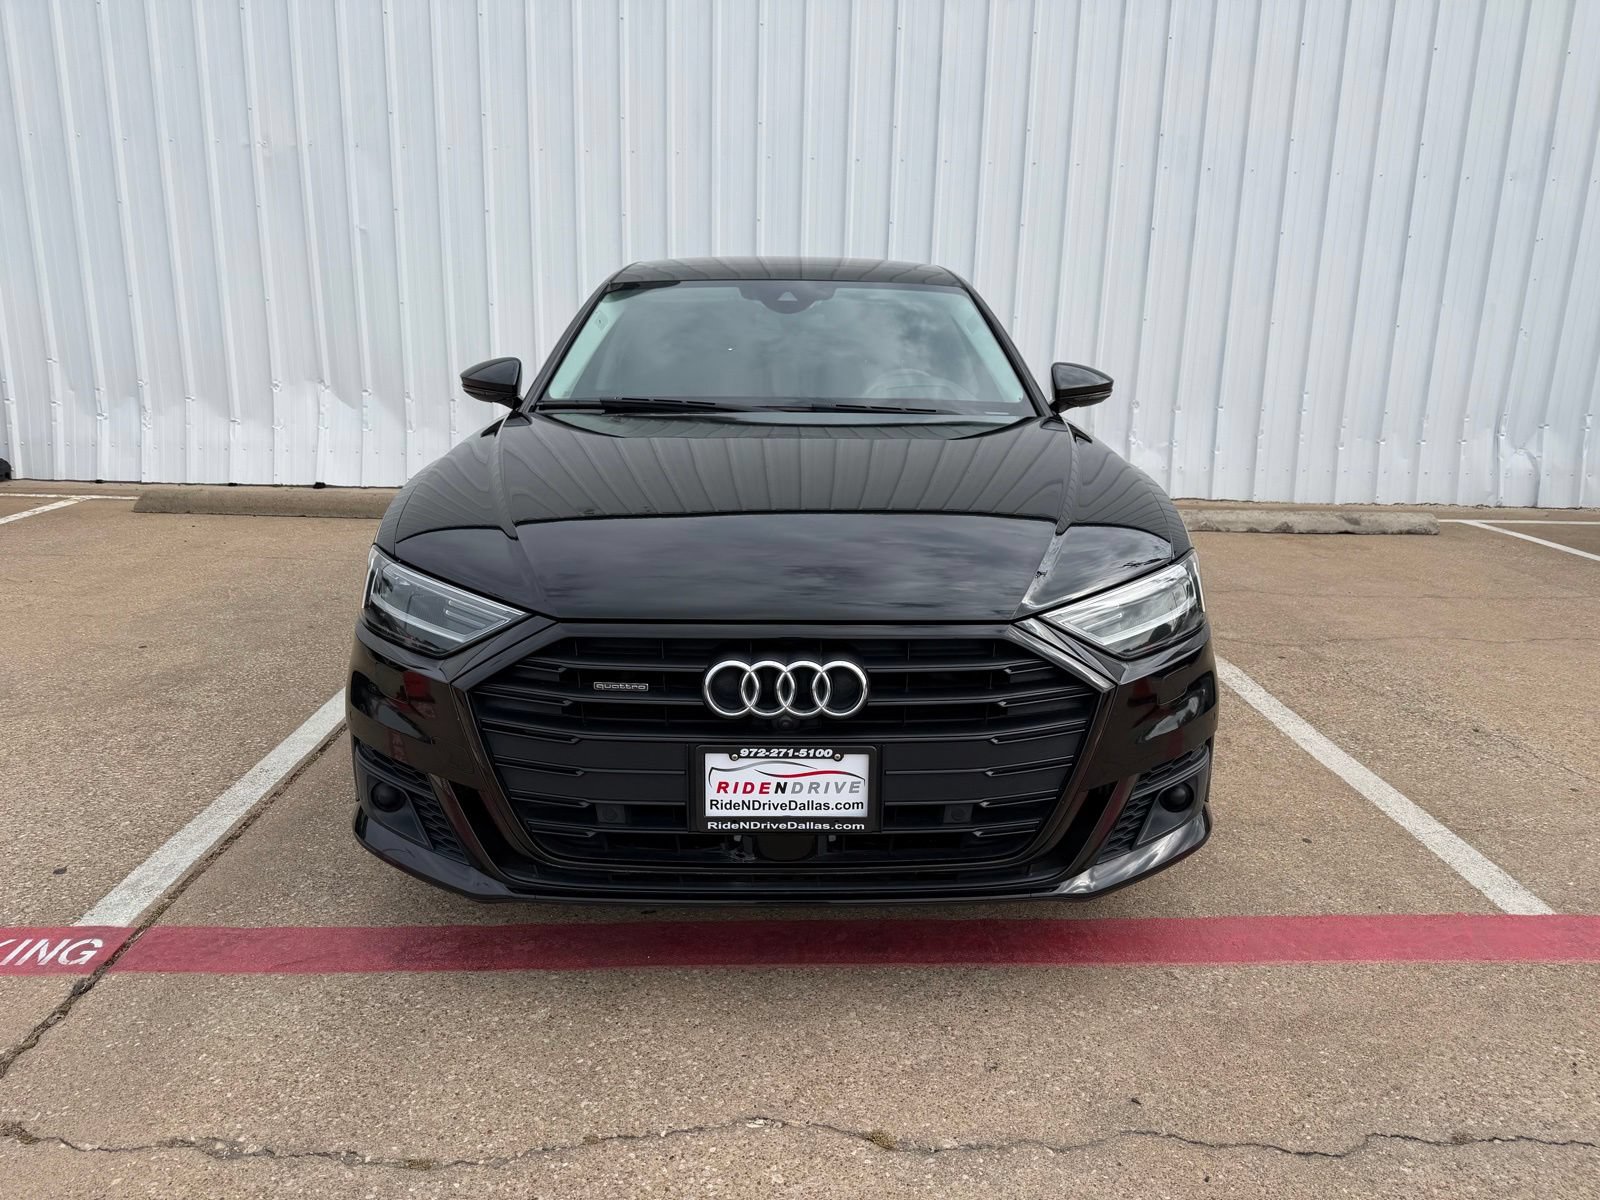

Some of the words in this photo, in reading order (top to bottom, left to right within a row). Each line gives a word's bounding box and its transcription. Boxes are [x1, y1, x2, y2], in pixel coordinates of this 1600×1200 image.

[595, 682, 647, 691] quattro
[739, 748, 833, 758] 972-271-5100
[716, 781, 862, 795] RIDENDRIVE
[709, 799, 864, 811] RideNDriveDallas.com
[707, 821, 865, 830] RideNDriveDallas.com
